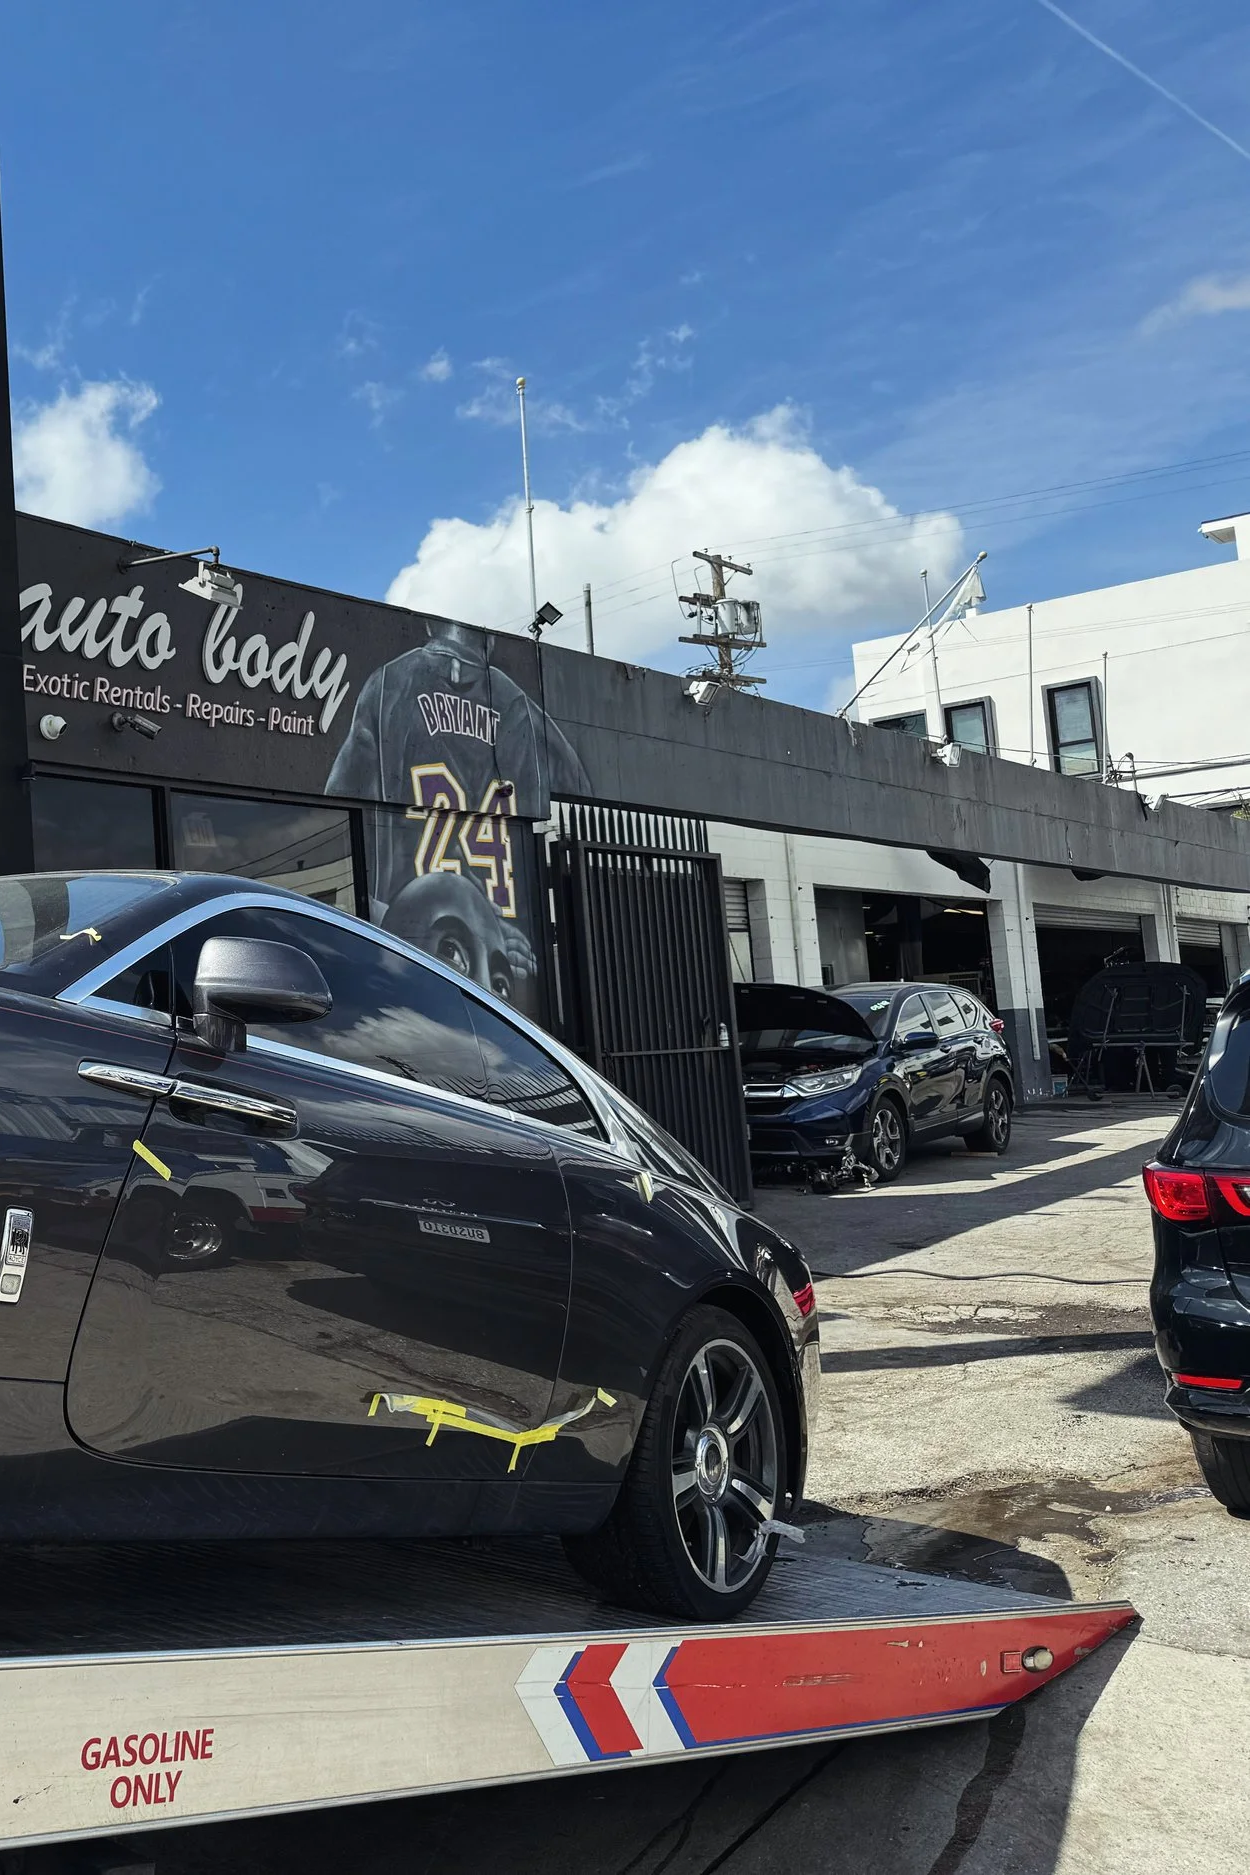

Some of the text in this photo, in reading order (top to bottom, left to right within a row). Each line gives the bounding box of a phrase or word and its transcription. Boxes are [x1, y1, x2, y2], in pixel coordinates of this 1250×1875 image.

[19, 583, 350, 734] auto body
[23, 664, 90, 701] Exotic
[93, 677, 171, 714] Rentals
[185, 693, 255, 728] Repairs
[267, 706, 314, 736] Paint
[417, 692, 501, 746] BRYANT
[405, 762, 517, 918] 24
[81, 1728, 214, 1771] GASOLINE
[110, 1770, 183, 1809] ONLY
